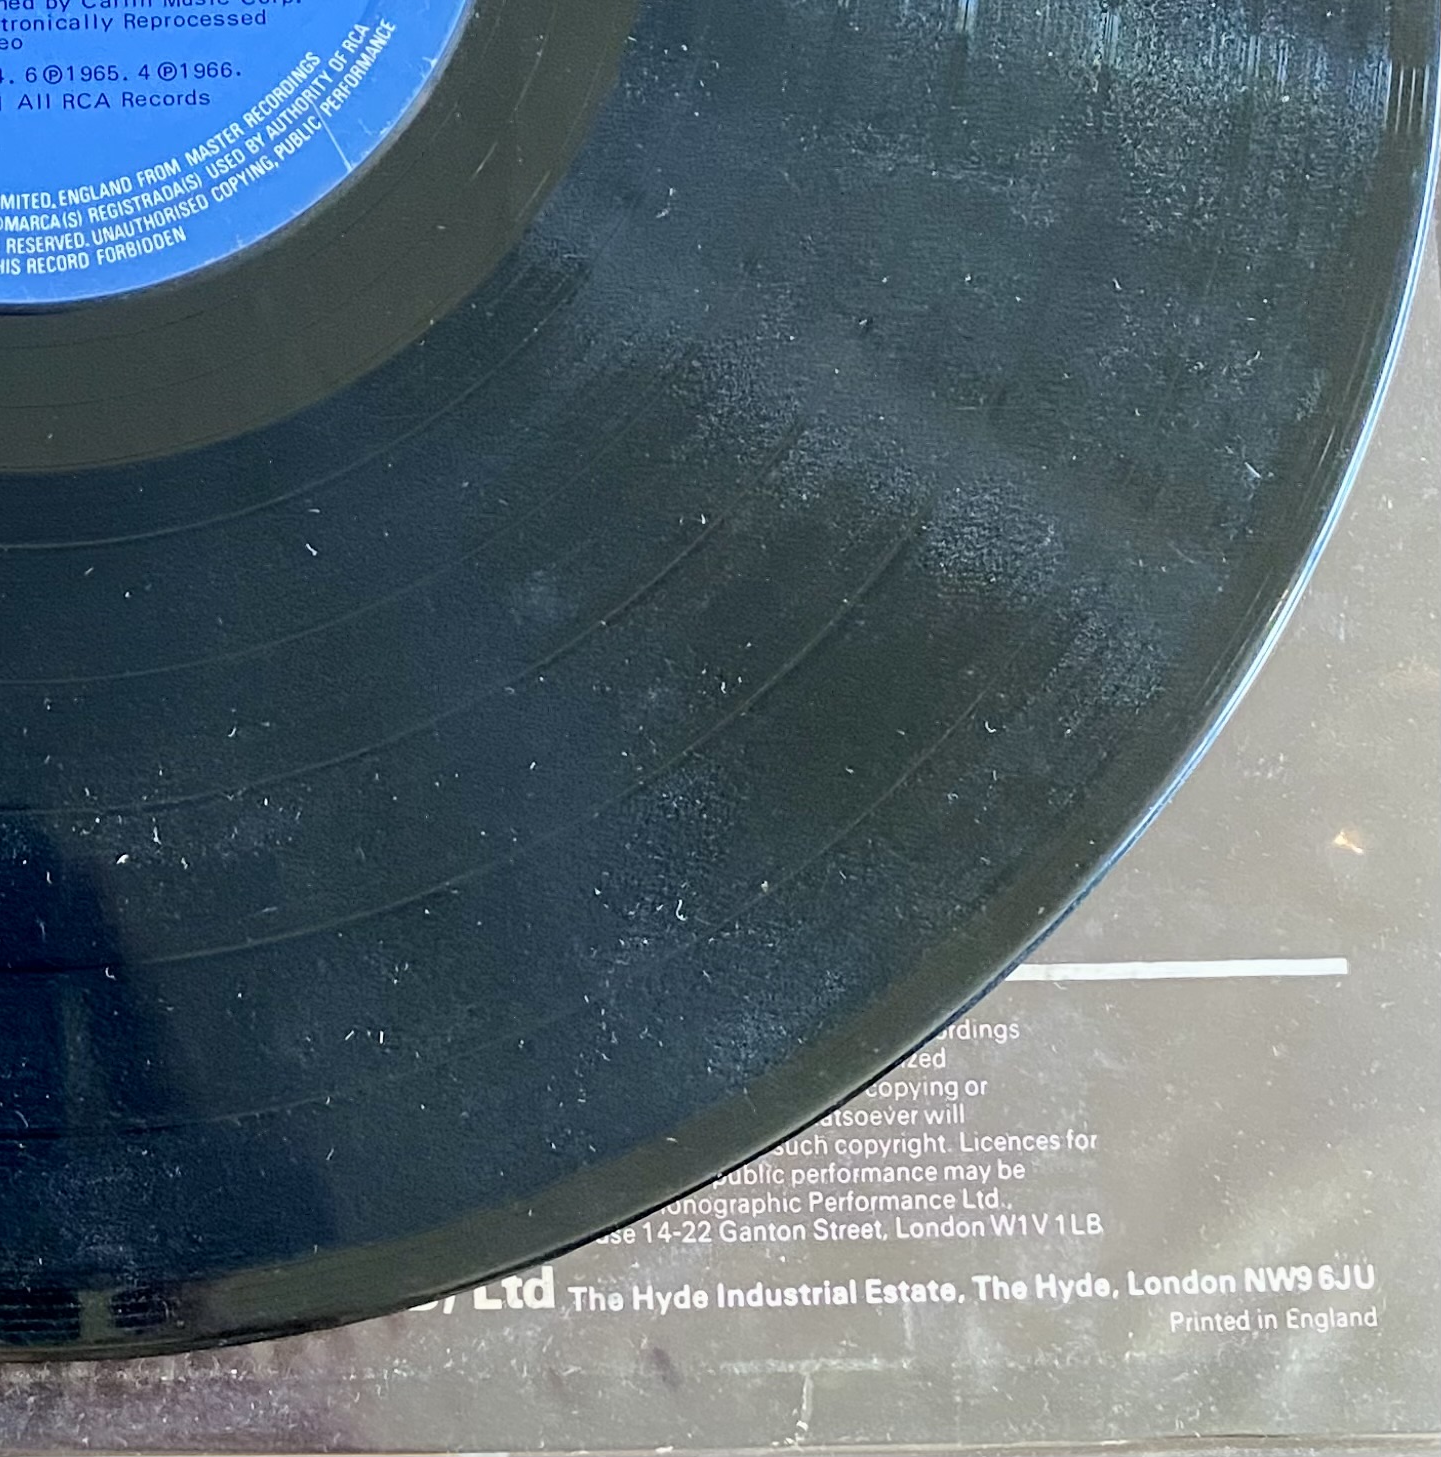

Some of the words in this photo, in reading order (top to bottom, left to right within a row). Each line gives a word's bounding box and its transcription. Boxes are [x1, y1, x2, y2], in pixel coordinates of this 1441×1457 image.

[124, 10, 267, 30] Reprocessed
[18, 93, 51, 110] All
[62, 93, 110, 109] RCA
[122, 90, 210, 107] Records
[206, 148, 246, 179] USED
[265, 70, 334, 145] AUTHORITY
[341, 23, 371, 55] RCA
[59, 176, 133, 206] ENGLAND
[136, 157, 181, 187] FROM
[184, 122, 245, 167] MASTER
[243, 51, 322, 128] RECORDINGS
[91, 193, 209, 245] UNAUTHORISED
[211, 154, 279, 202] COPYING,
[274, 115, 322, 161] PUBLIC
[319, 18, 396, 118] PERFORMANCE
[27, 252, 89, 275] RECORD
[97, 226, 186, 265] FORBIDDEN
[925, 1103, 965, 1124] will
[960, 1131, 1060, 1153] Licences
[1066, 1128, 1098, 1151] for
[791, 1163, 937, 1188] performance
[944, 1164, 991, 1185] may
[997, 1159, 1026, 1180] be
[809, 1190, 956, 1213] Performance
[642, 1221, 712, 1244] 14-22
[719, 1220, 806, 1242] Ganton
[813, 1218, 888, 1242] Street,
[896, 1216, 985, 1239] London
[568, 1286, 625, 1312] The
[633, 1285, 709, 1316] Hyde
[717, 1280, 858, 1309] Industrial
[865, 1277, 965, 1305] Estate,
[972, 1275, 1028, 1301] The
[1035, 1273, 1119, 1304] Hyde,
[1127, 1269, 1236, 1297] London
[1243, 1266, 1313, 1295] NW9
[1318, 1263, 1376, 1292] 6JU
[1170, 1310, 1250, 1334] Printed
[1257, 1309, 1277, 1331] in
[1286, 1307, 1379, 1334] England
